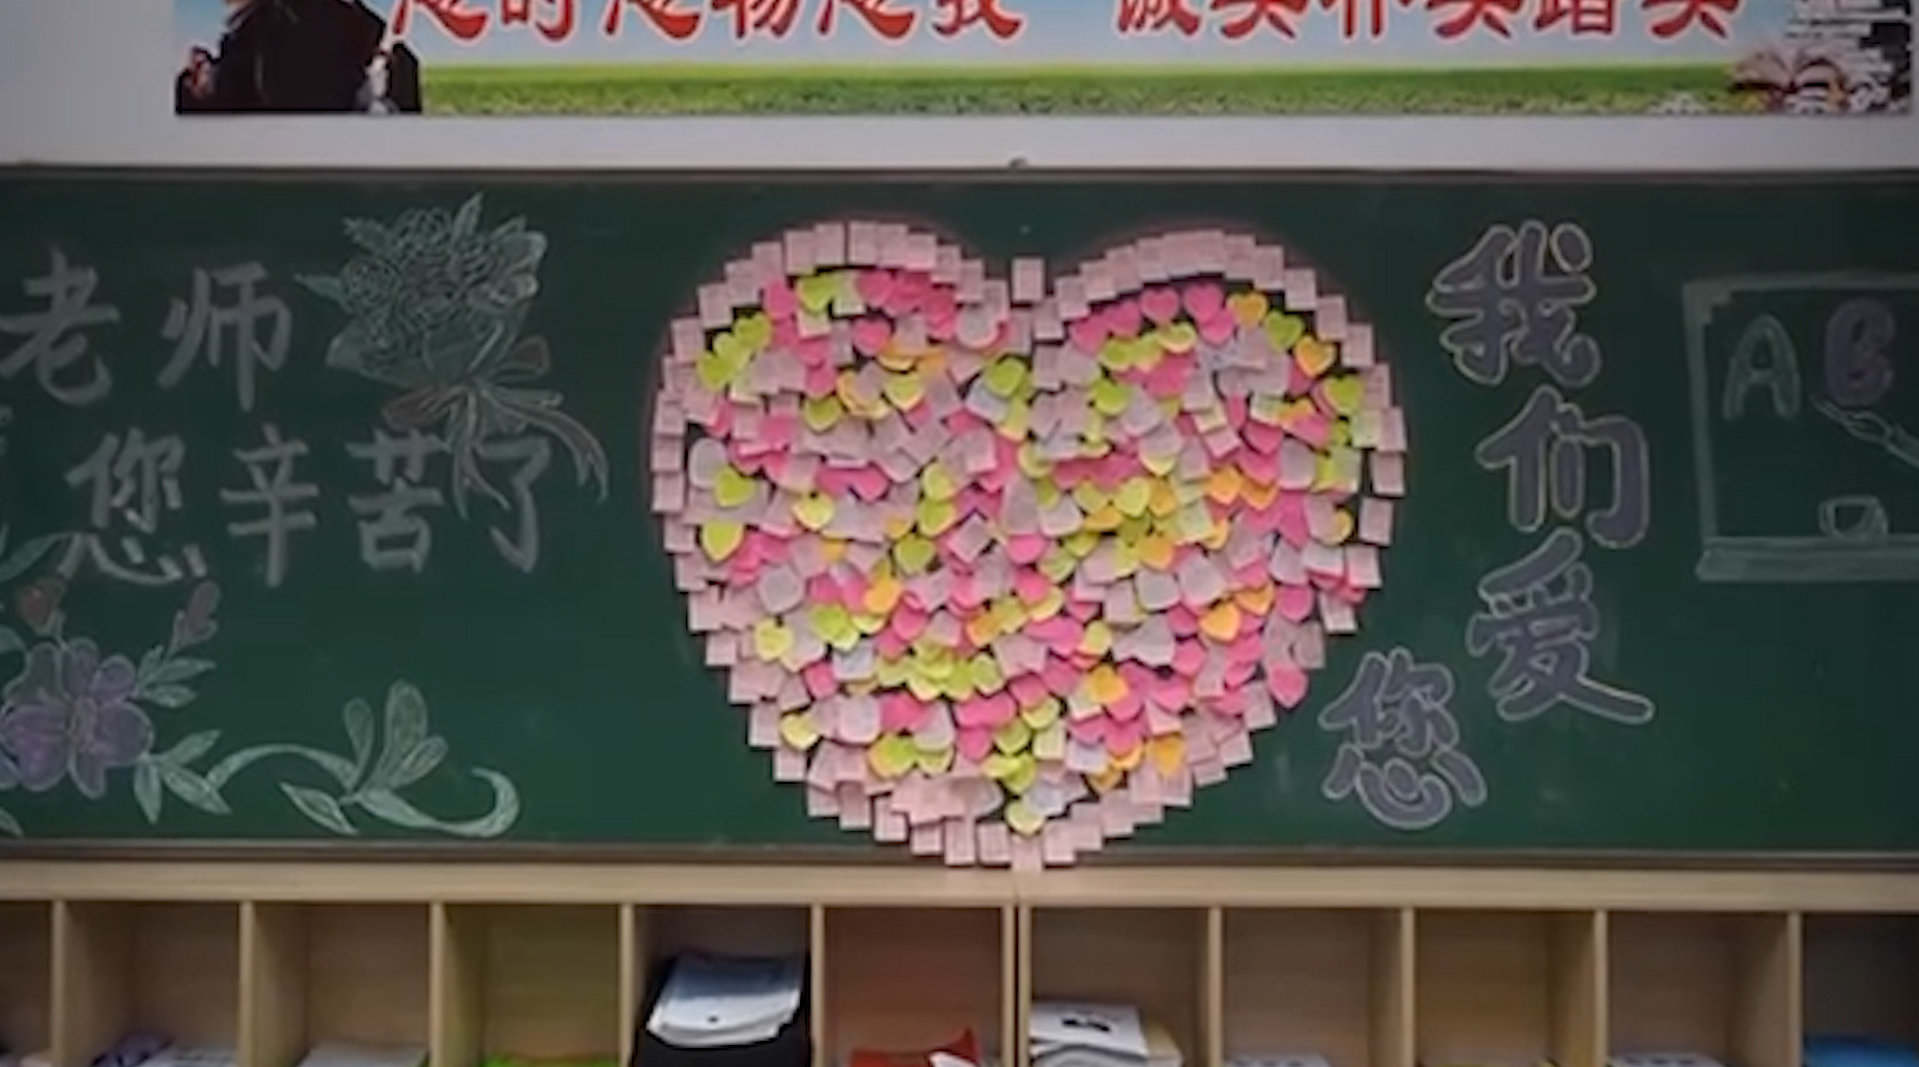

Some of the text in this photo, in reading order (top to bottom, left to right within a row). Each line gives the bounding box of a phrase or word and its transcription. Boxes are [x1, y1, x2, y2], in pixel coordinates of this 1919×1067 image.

[0, 245, 293, 412] 老师
[57, 422, 552, 588] 您辛苦了
